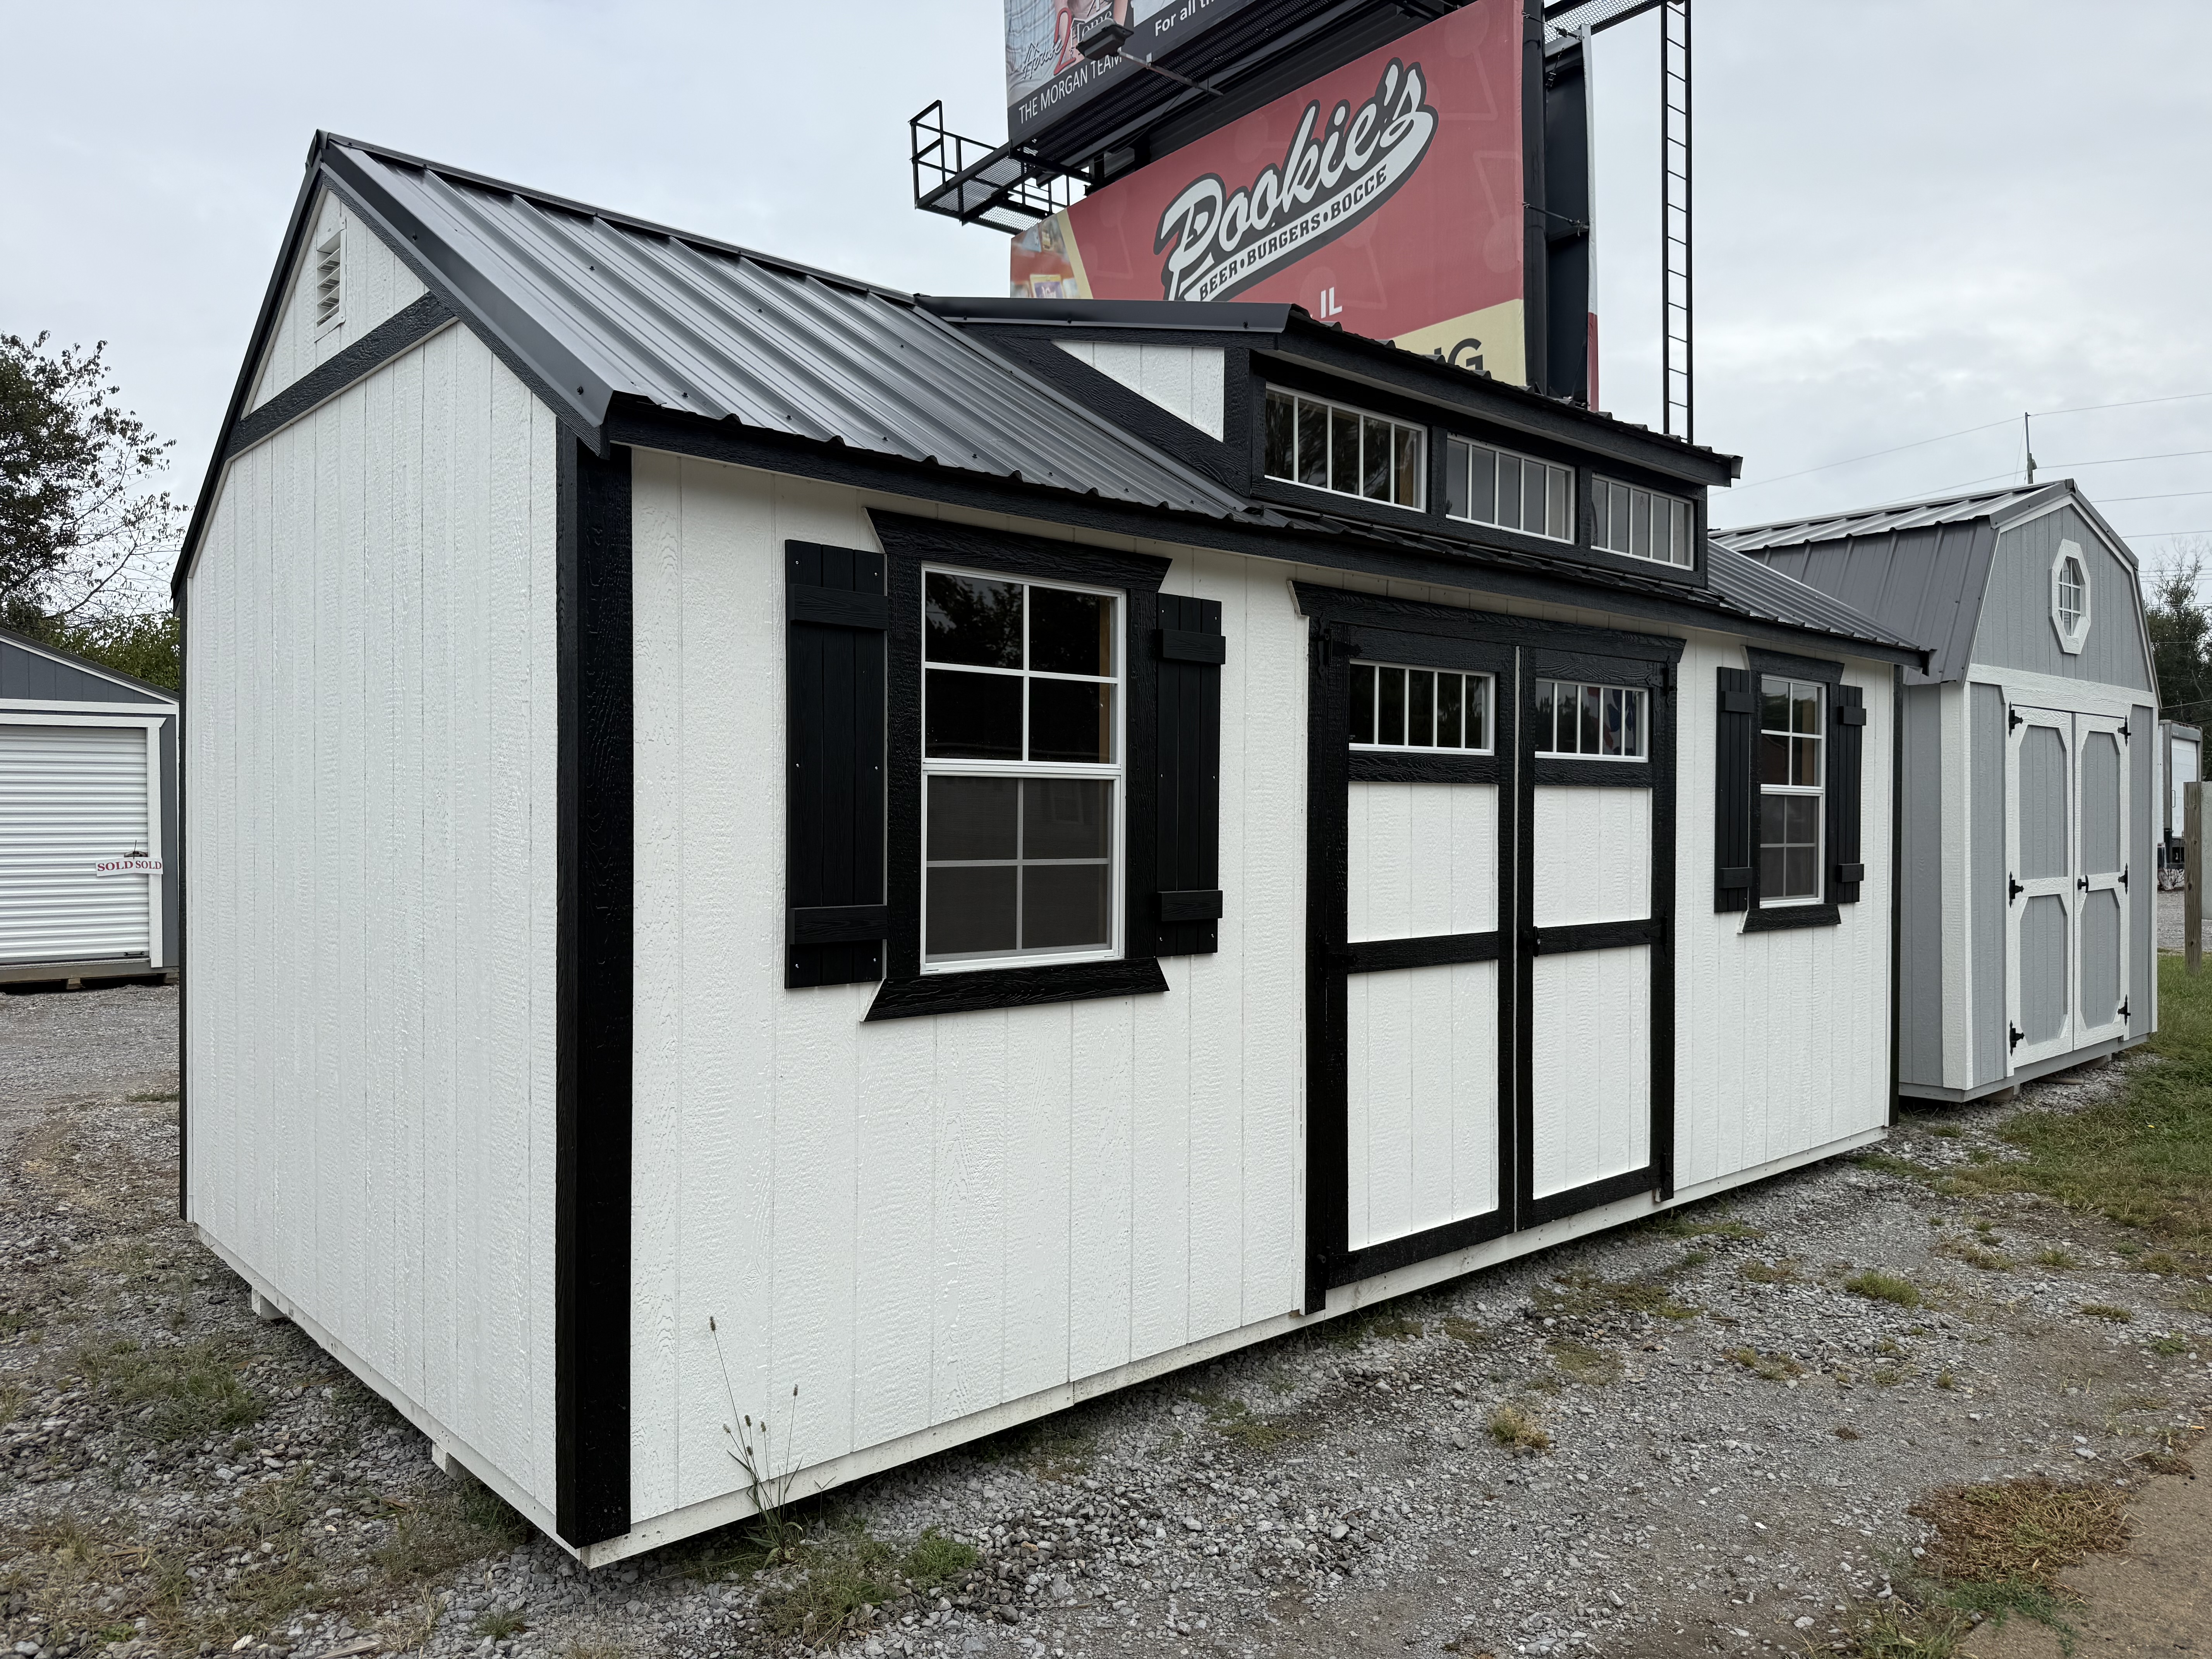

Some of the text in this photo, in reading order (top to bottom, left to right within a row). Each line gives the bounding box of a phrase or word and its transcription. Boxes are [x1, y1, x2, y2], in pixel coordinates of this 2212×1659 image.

[1023, 39, 1064, 79] House
[1054, 7, 1076, 76] 2
[1155, 0, 1195, 36] For all
[1019, 47, 1122, 124] THE MORGAN TEAM
[1161, 64, 1433, 301] Pookie's
[1199, 163, 1387, 301] BEER BURGERS BOCCE
[1321, 287, 1342, 319] IL
[98, 861, 133, 871] SOLD
[136, 860, 161, 869] SOLD
